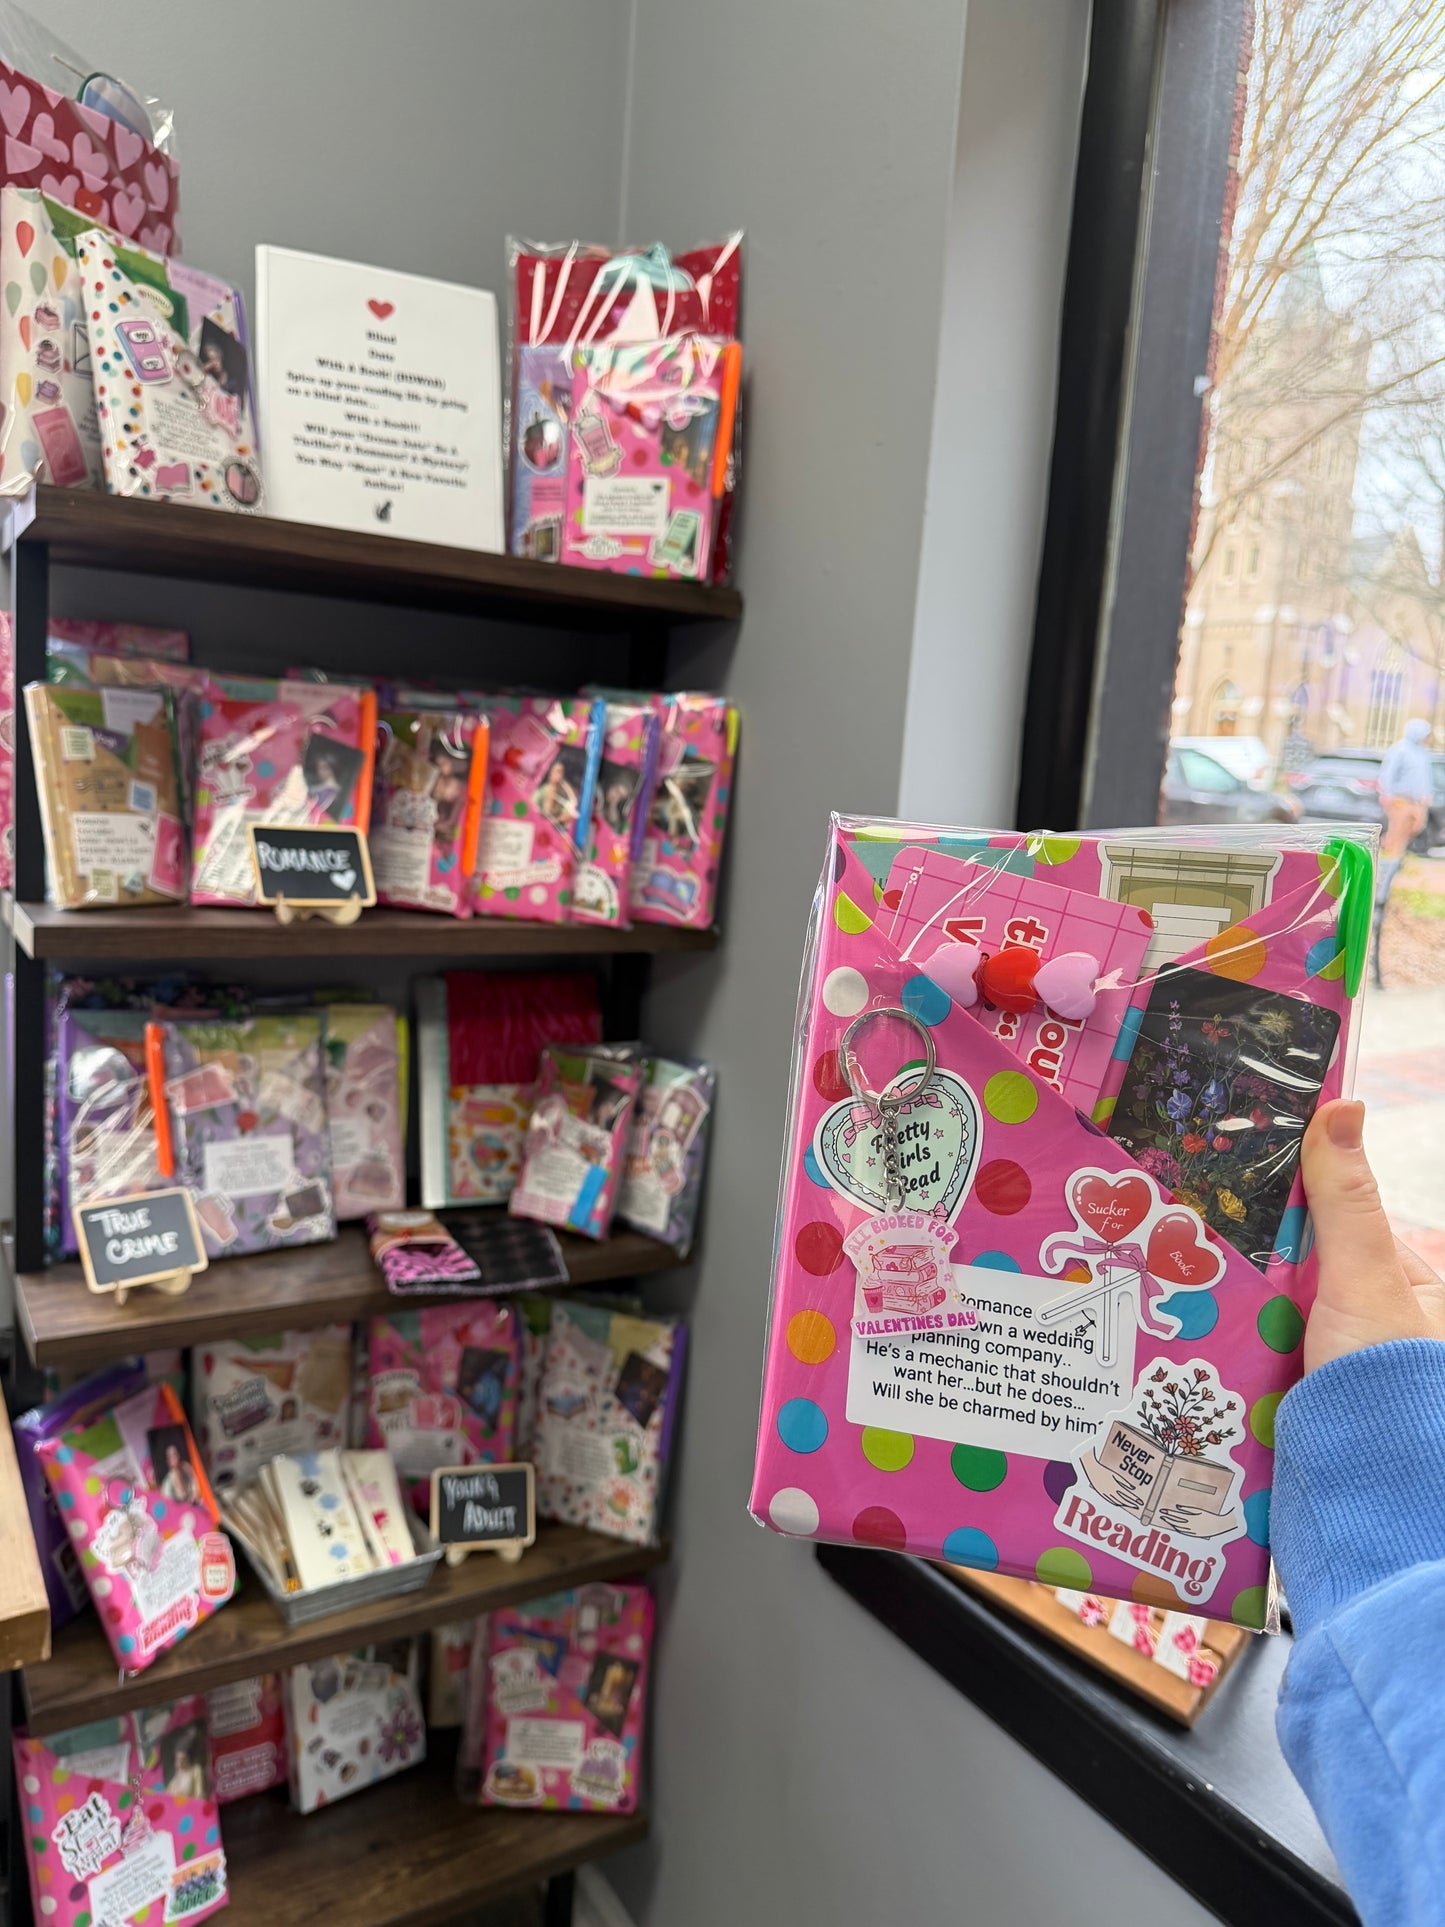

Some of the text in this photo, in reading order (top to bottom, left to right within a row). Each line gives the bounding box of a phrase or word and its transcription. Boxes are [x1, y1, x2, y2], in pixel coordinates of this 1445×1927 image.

[870, 1119, 930, 1155] Petty
[897, 1161, 941, 1197] Read
[1087, 1199, 1130, 1217] Sucker
[1099, 1216, 1124, 1233] for
[105, 1230, 179, 1265] CRIME
[845, 1213, 957, 1256] ALL BOOKED FOR
[1169, 1250, 1196, 1277] Books
[855, 1310, 977, 1337] VALENTINES DAY
[1008, 1326, 1018, 1339] a
[1022, 1327, 1095, 1355] wedding
[911, 1331, 1073, 1368] planning company..
[866, 1340, 1121, 1397] He's a mechanic that shouldn't
[894, 1365, 933, 1385] want
[1007, 1382, 1027, 1401] he
[1031, 1388, 1086, 1411] does...
[872, 1380, 1104, 1436] Will she be charmed by him
[1111, 1430, 1155, 1465] Never
[1118, 1454, 1154, 1487] Stop
[1062, 1494, 1218, 1597] Reading
